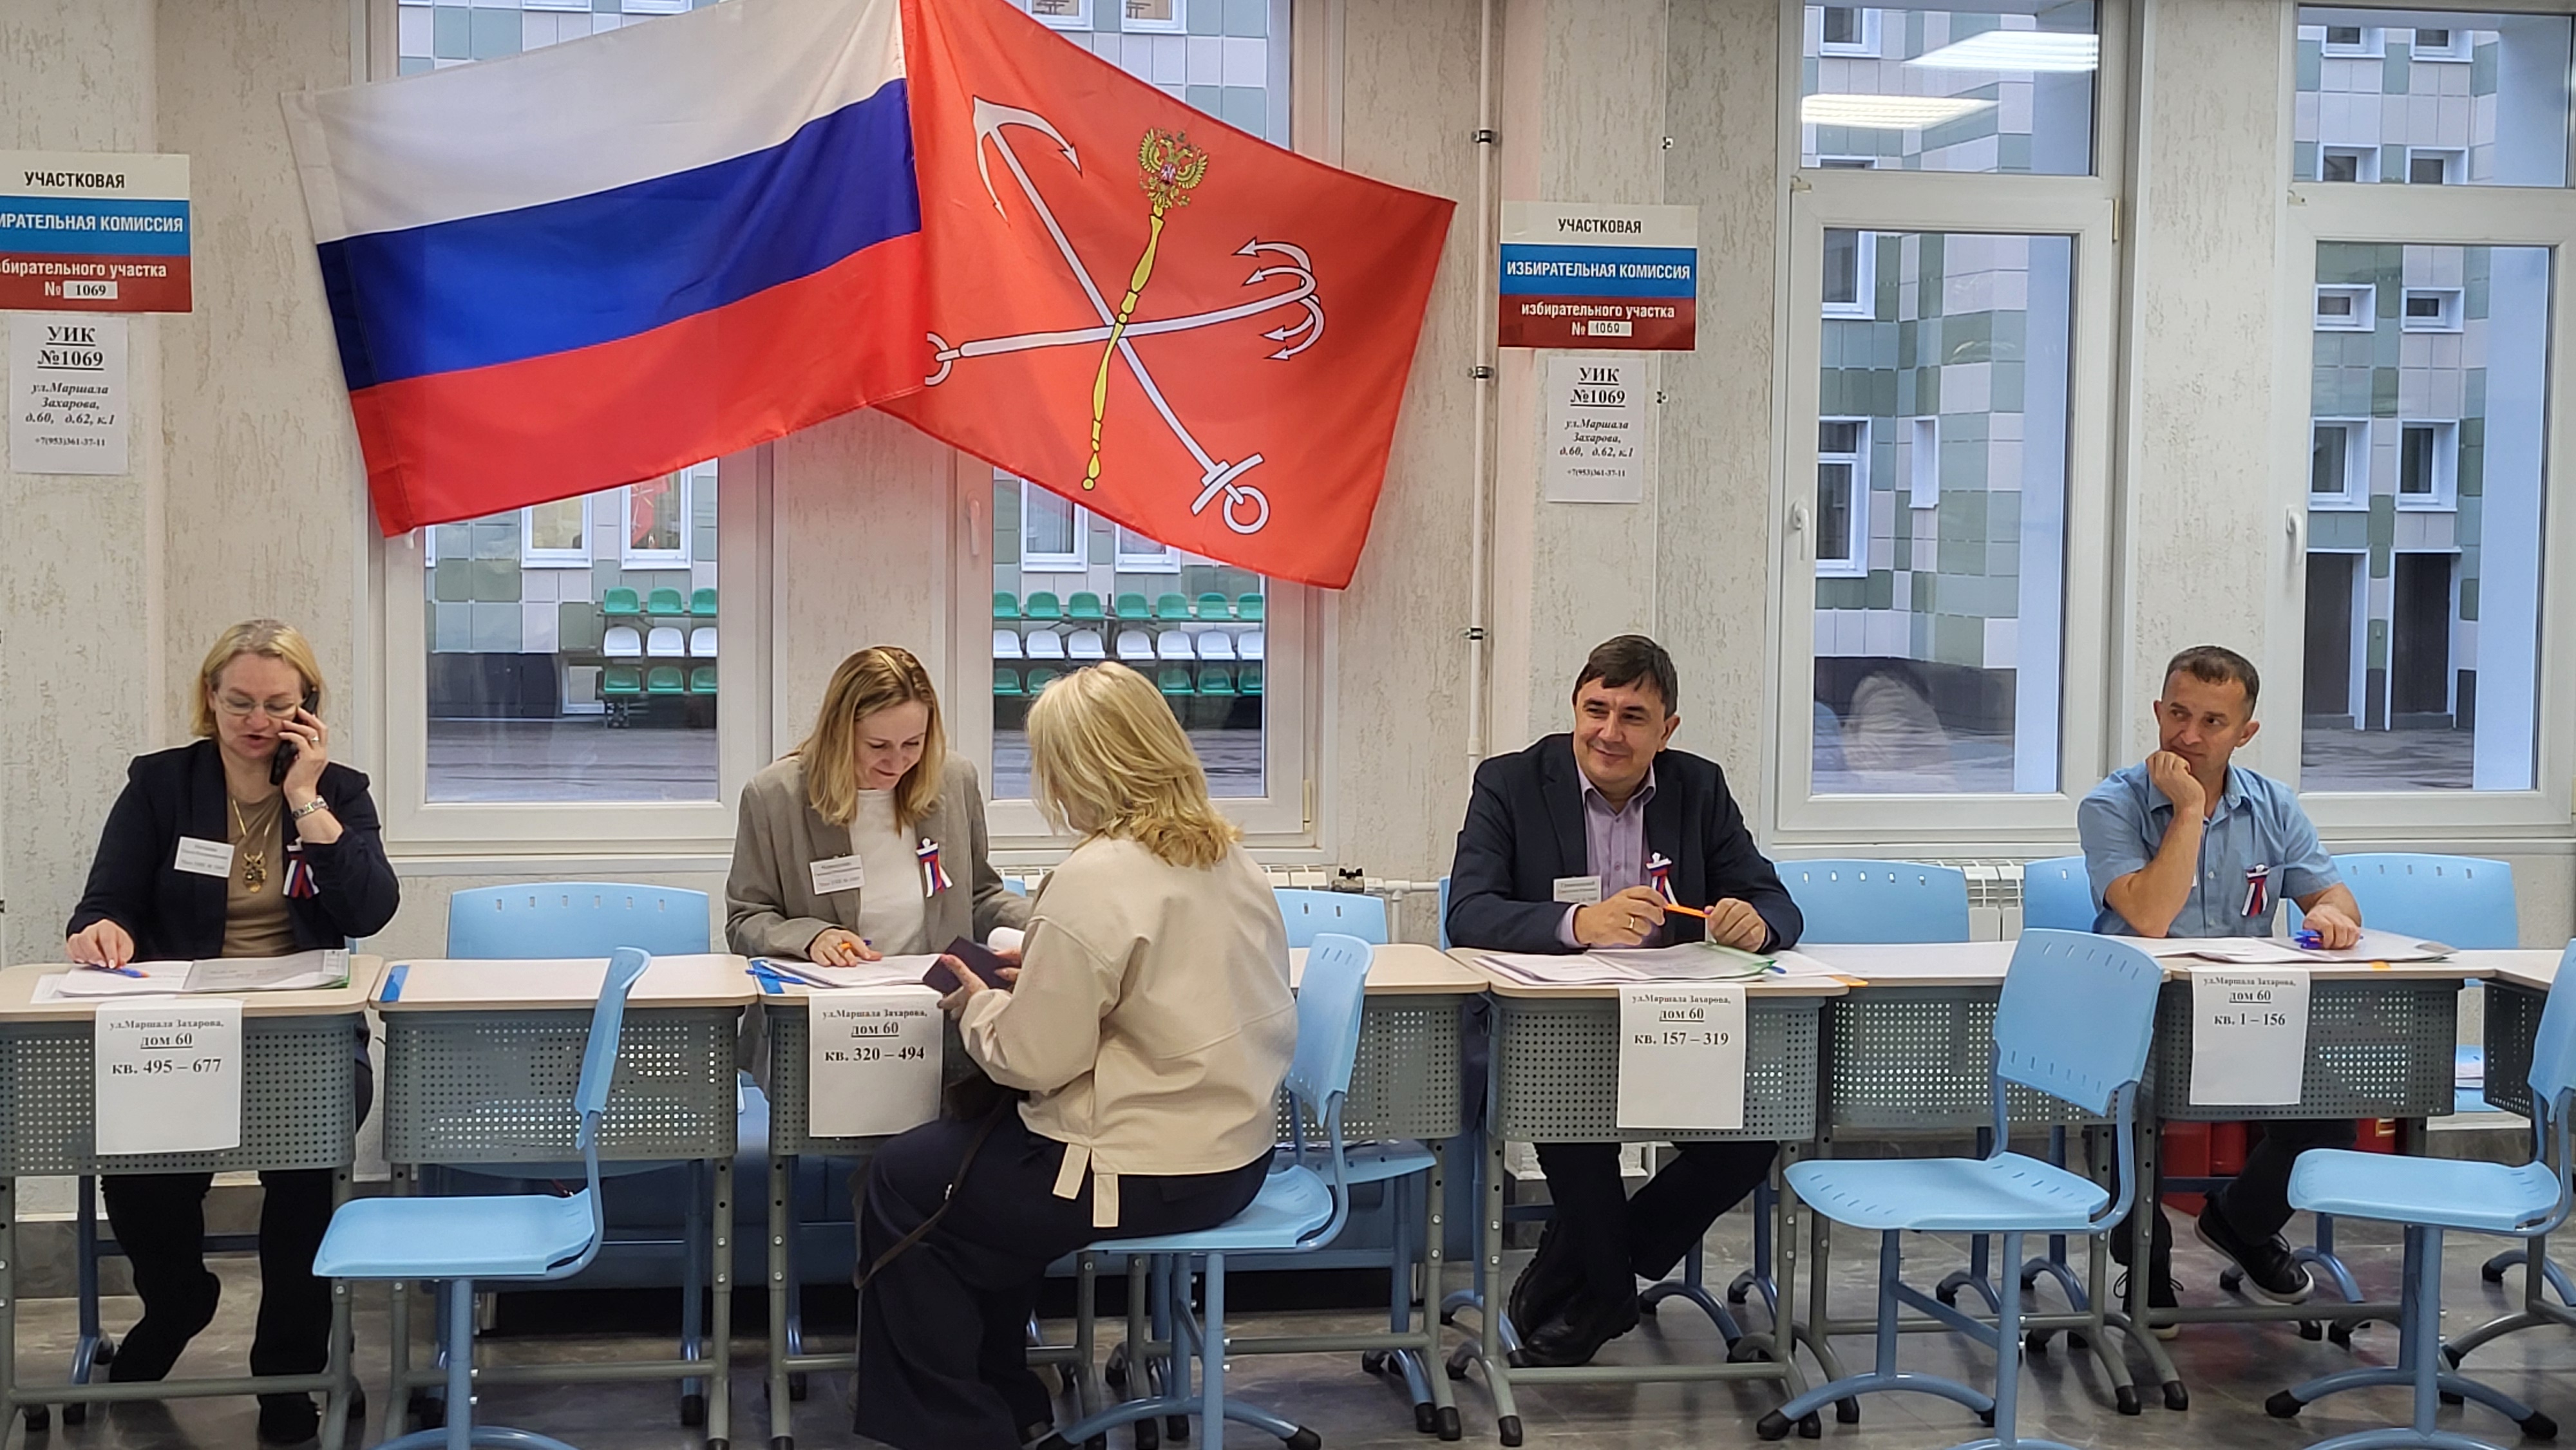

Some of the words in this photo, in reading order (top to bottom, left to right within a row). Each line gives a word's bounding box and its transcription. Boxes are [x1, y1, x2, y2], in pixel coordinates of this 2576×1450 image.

[24, 171, 125, 188] УЧАСТКОВАЯ
[100, 216, 183, 232] КОМИССИЯ
[1558, 218, 1642, 234] УЧАСТКОВАЯ
[0, 258, 105, 278] бирательного
[109, 265, 167, 279] участка
[1506, 261, 1616, 278] ИЗБИРАТЕЛЬНАЯ
[1620, 265, 1690, 279] КОМИССИЯ
[76, 284, 106, 296] 1069
[1522, 301, 1622, 318] избирательного
[1625, 306, 1674, 319] участка
[47, 326, 95, 343] УИК
[37, 350, 103, 366] №1069
[1579, 367, 1620, 382] УИК
[31, 382, 109, 395] ул.Маршала
[41, 397, 99, 411] Захарова,
[1571, 389, 1625, 404] №1069
[2230, 992, 2253, 1002] дом
[2257, 990, 2271, 1001] 60
[1660, 1010, 1684, 1021] дом
[1689, 1008, 1704, 1019] 60
[2214, 1015, 2235, 1025] кв.
[2241, 1013, 2246, 1024] 1
[2264, 1013, 2286, 1025] 156
[851, 1026, 878, 1036] дом
[883, 1022, 899, 1034] 60
[141, 1036, 170, 1048] дом
[175, 1033, 193, 1045] 60
[1634, 1035, 1656, 1044] кв.
[1663, 1032, 1687, 1045] 157
[1703, 1032, 1728, 1045] 319
[825, 1051, 849, 1061] кв.
[853, 1048, 880, 1061] 320
[898, 1046, 925, 1060] 494
[112, 1064, 138, 1074] кв.
[143, 1059, 173, 1073] 495
[193, 1059, 222, 1073] 677
